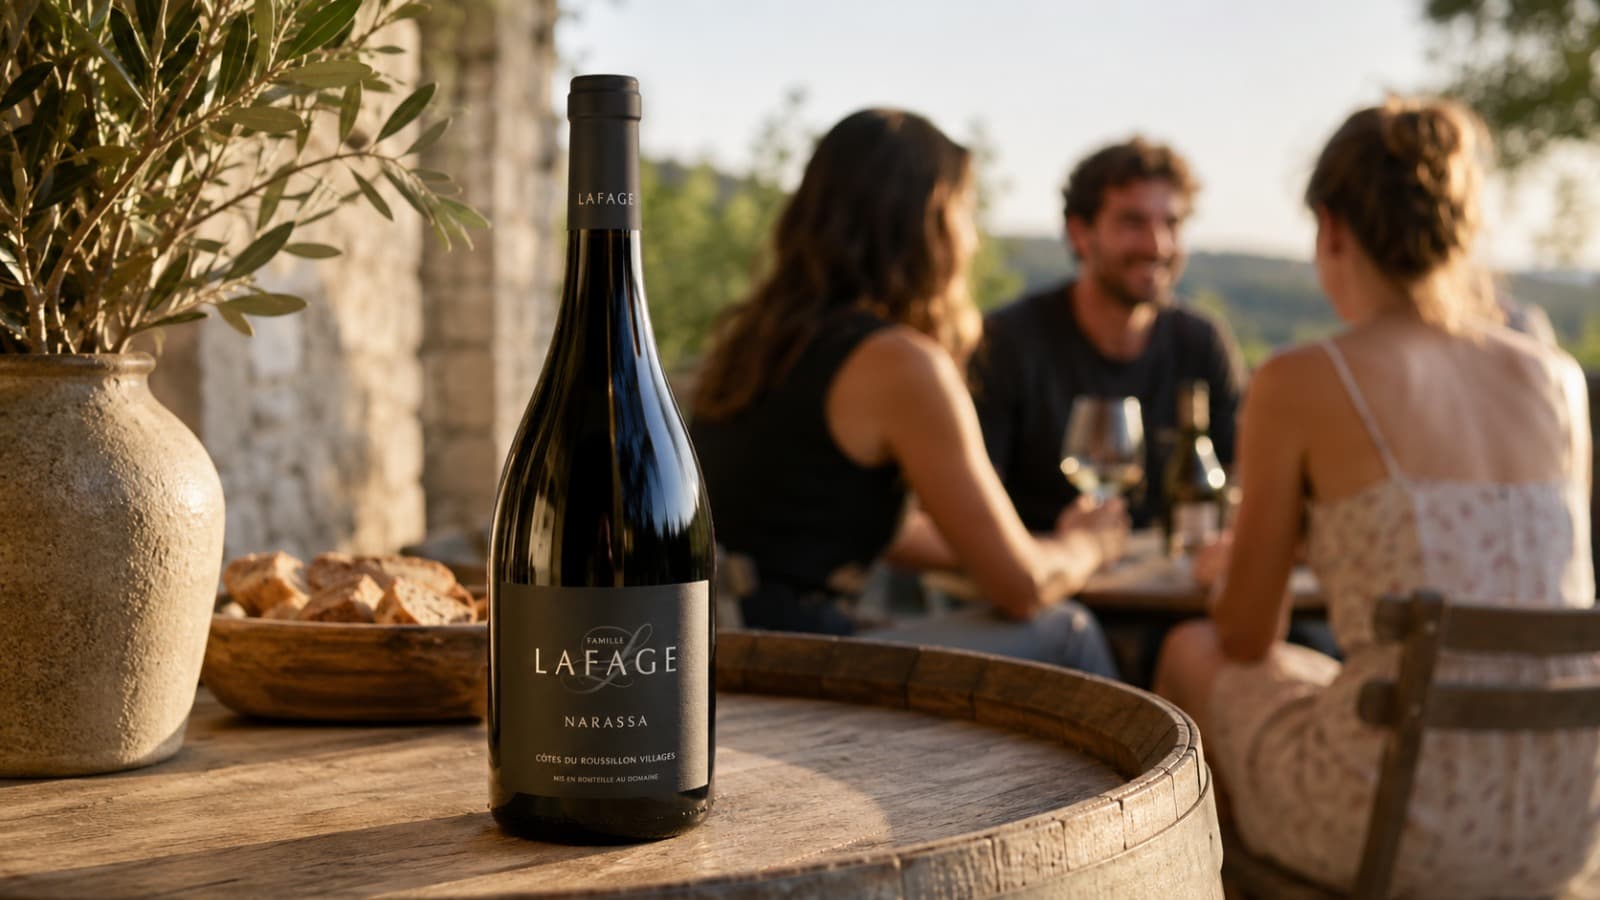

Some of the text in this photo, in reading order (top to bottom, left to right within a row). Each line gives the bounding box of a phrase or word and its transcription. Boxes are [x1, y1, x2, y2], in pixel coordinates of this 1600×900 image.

[578, 192, 634, 206] LAFAGE
[586, 636, 625, 645] FAMILLE
[535, 646, 677, 676] LAFAGE
[564, 715, 648, 729] NARASSA
[535, 751, 676, 765] CÔTES DU ROUSSILLON VILLAGES
[616, 775, 626, 783] AU
[628, 773, 659, 782] DOMAINE
